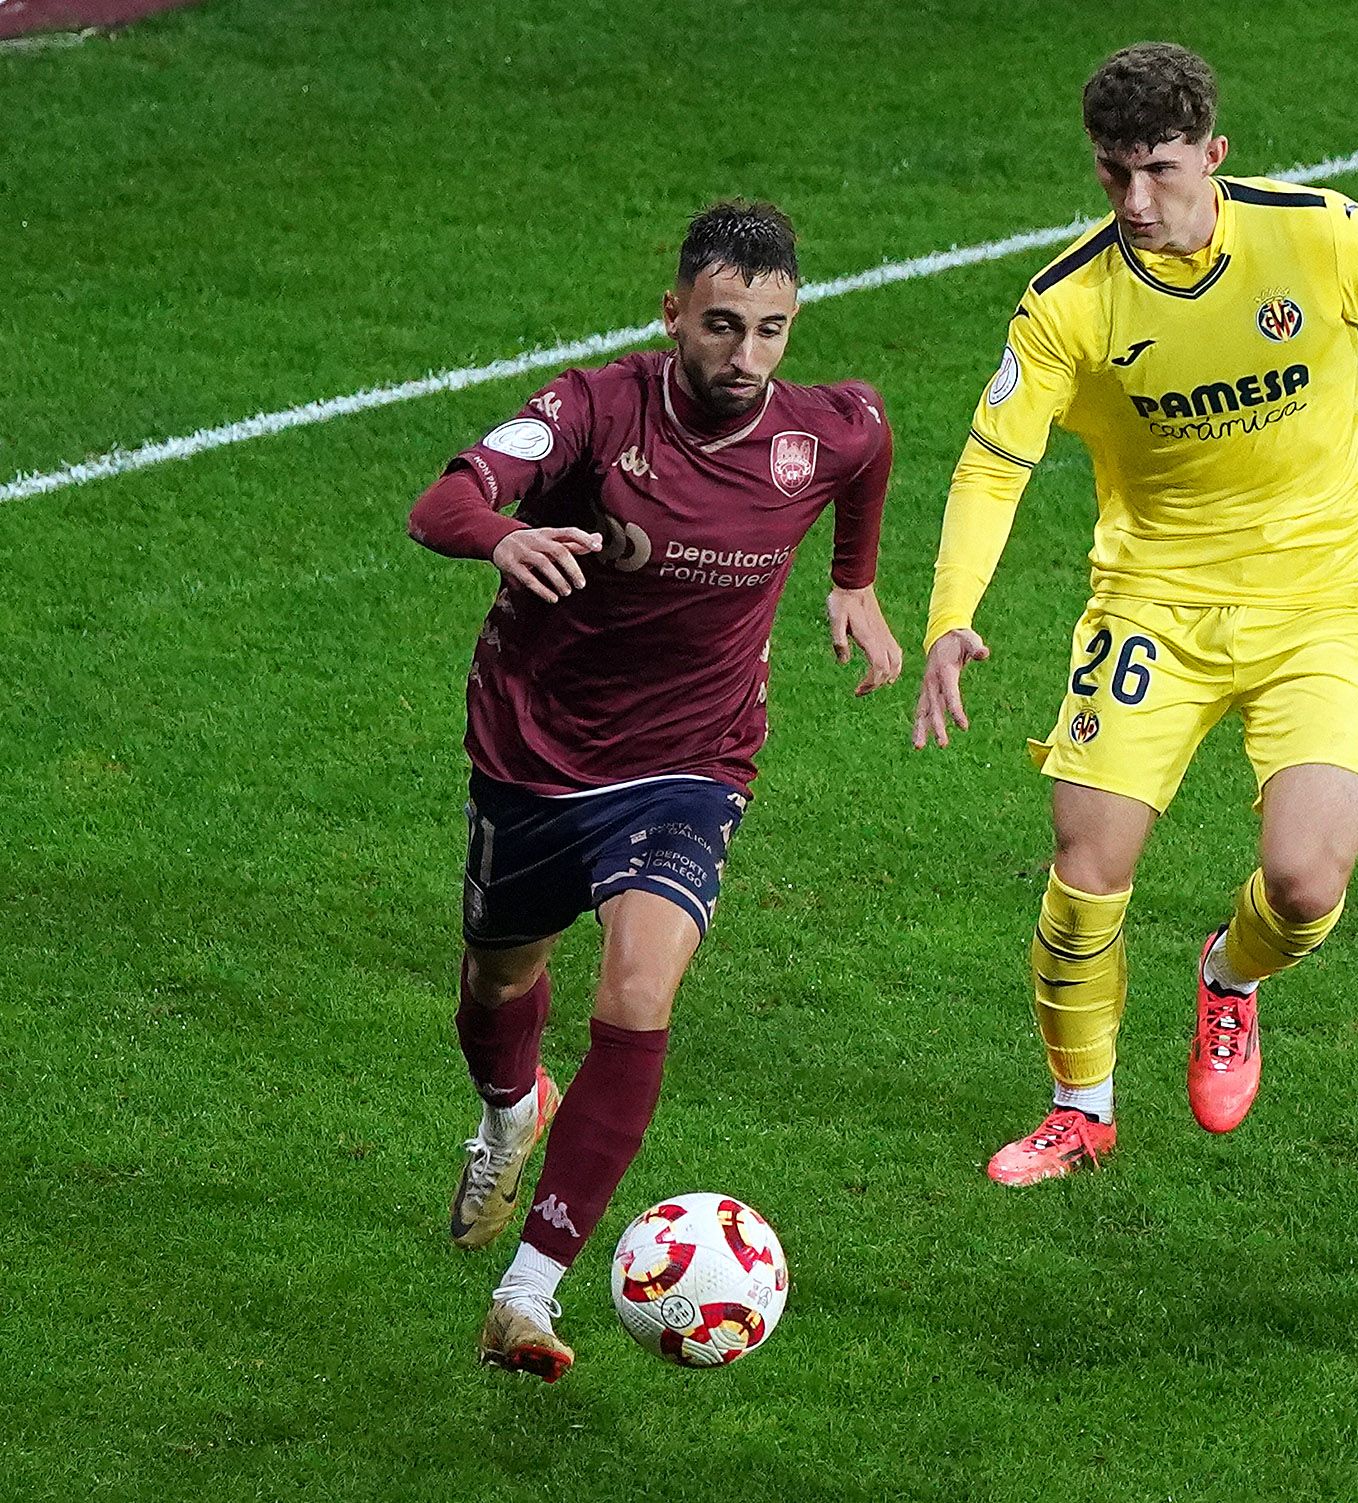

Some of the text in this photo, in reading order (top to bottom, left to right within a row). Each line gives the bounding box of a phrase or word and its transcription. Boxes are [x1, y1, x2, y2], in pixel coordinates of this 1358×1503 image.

[1129, 364, 1309, 418] PAMESA
[1150, 401, 1307, 440] cerámica
[665, 541, 792, 568] Deputació
[659, 562, 777, 588] Ponteved
[1072, 629, 1156, 705] 26
[652, 858, 702, 888] GALEGO
[655, 850, 708, 882] DEPORTE
